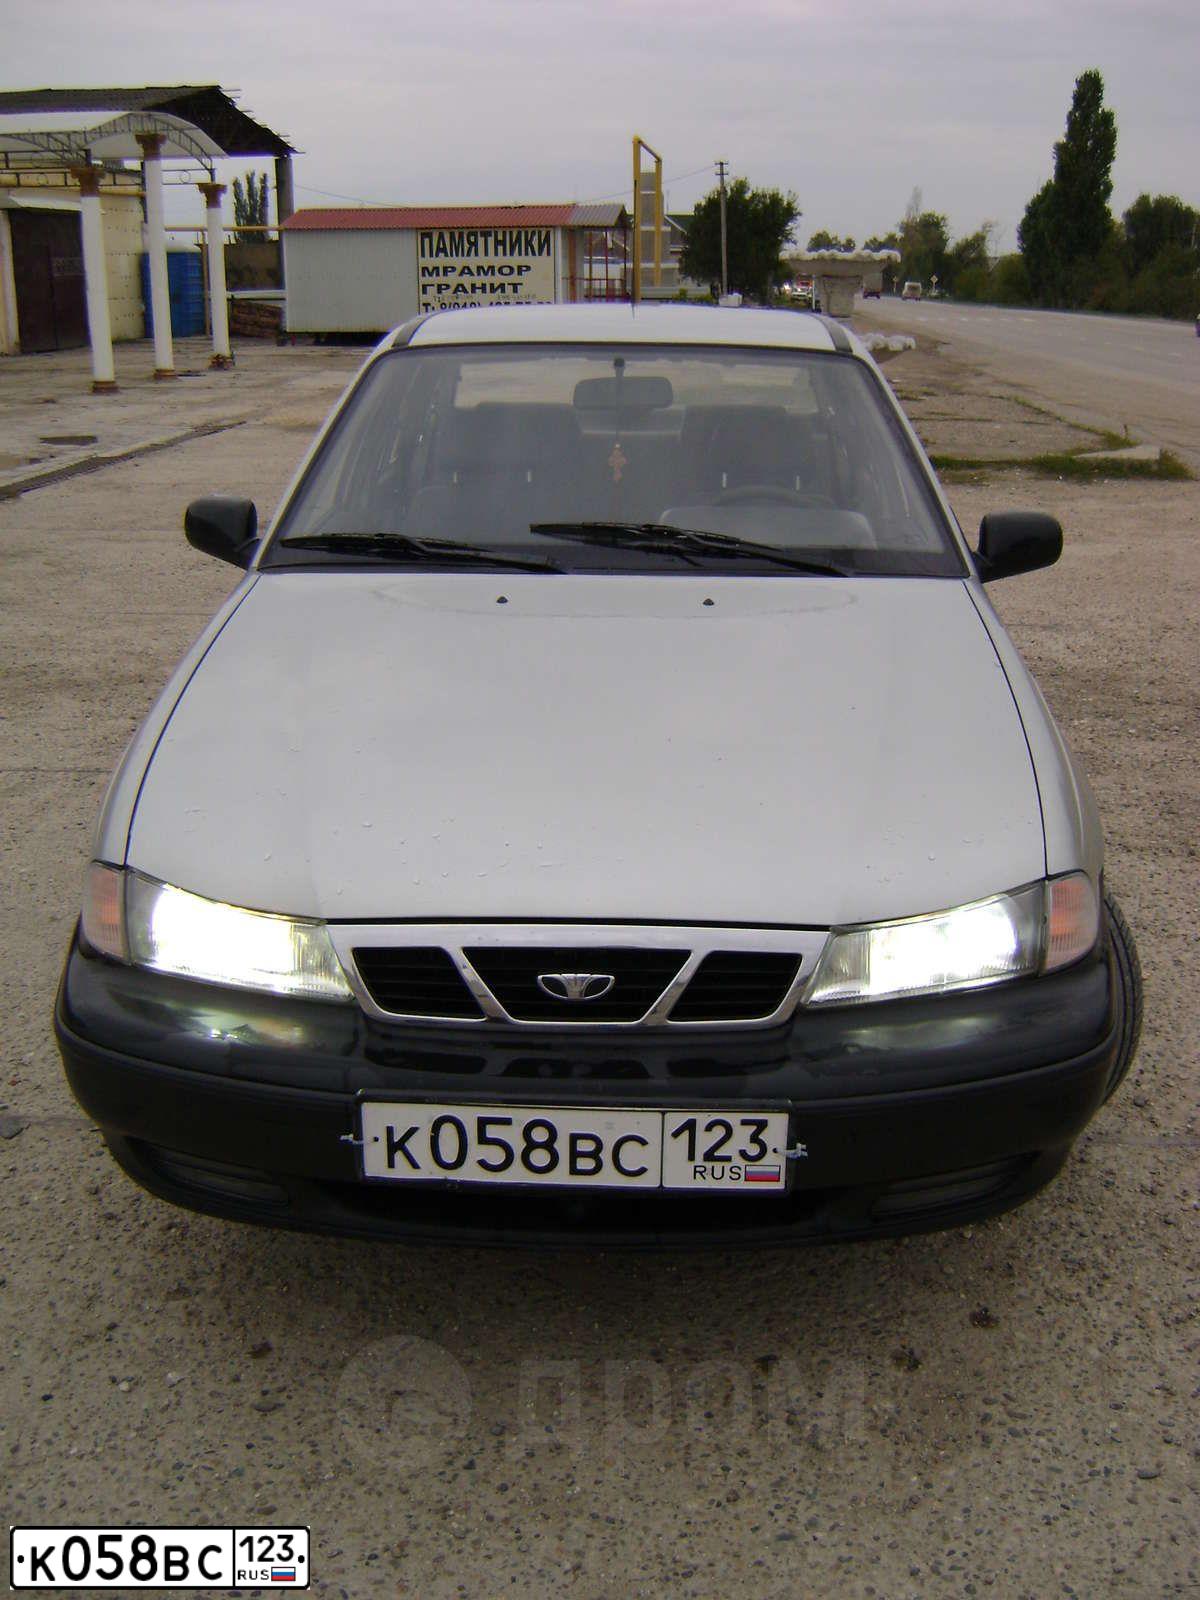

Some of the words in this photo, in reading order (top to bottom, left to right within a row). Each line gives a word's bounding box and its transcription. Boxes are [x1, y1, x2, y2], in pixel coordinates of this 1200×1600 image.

[420, 230, 551, 258] ПАМЯТНИКИ
[421, 265, 532, 277] МРАМОР
[422, 282, 524, 295] ГРАНИТ
[385, 1114, 649, 1177] К058ВС
[670, 1118, 769, 1163] 123
[693, 1165, 742, 1181] RUS
